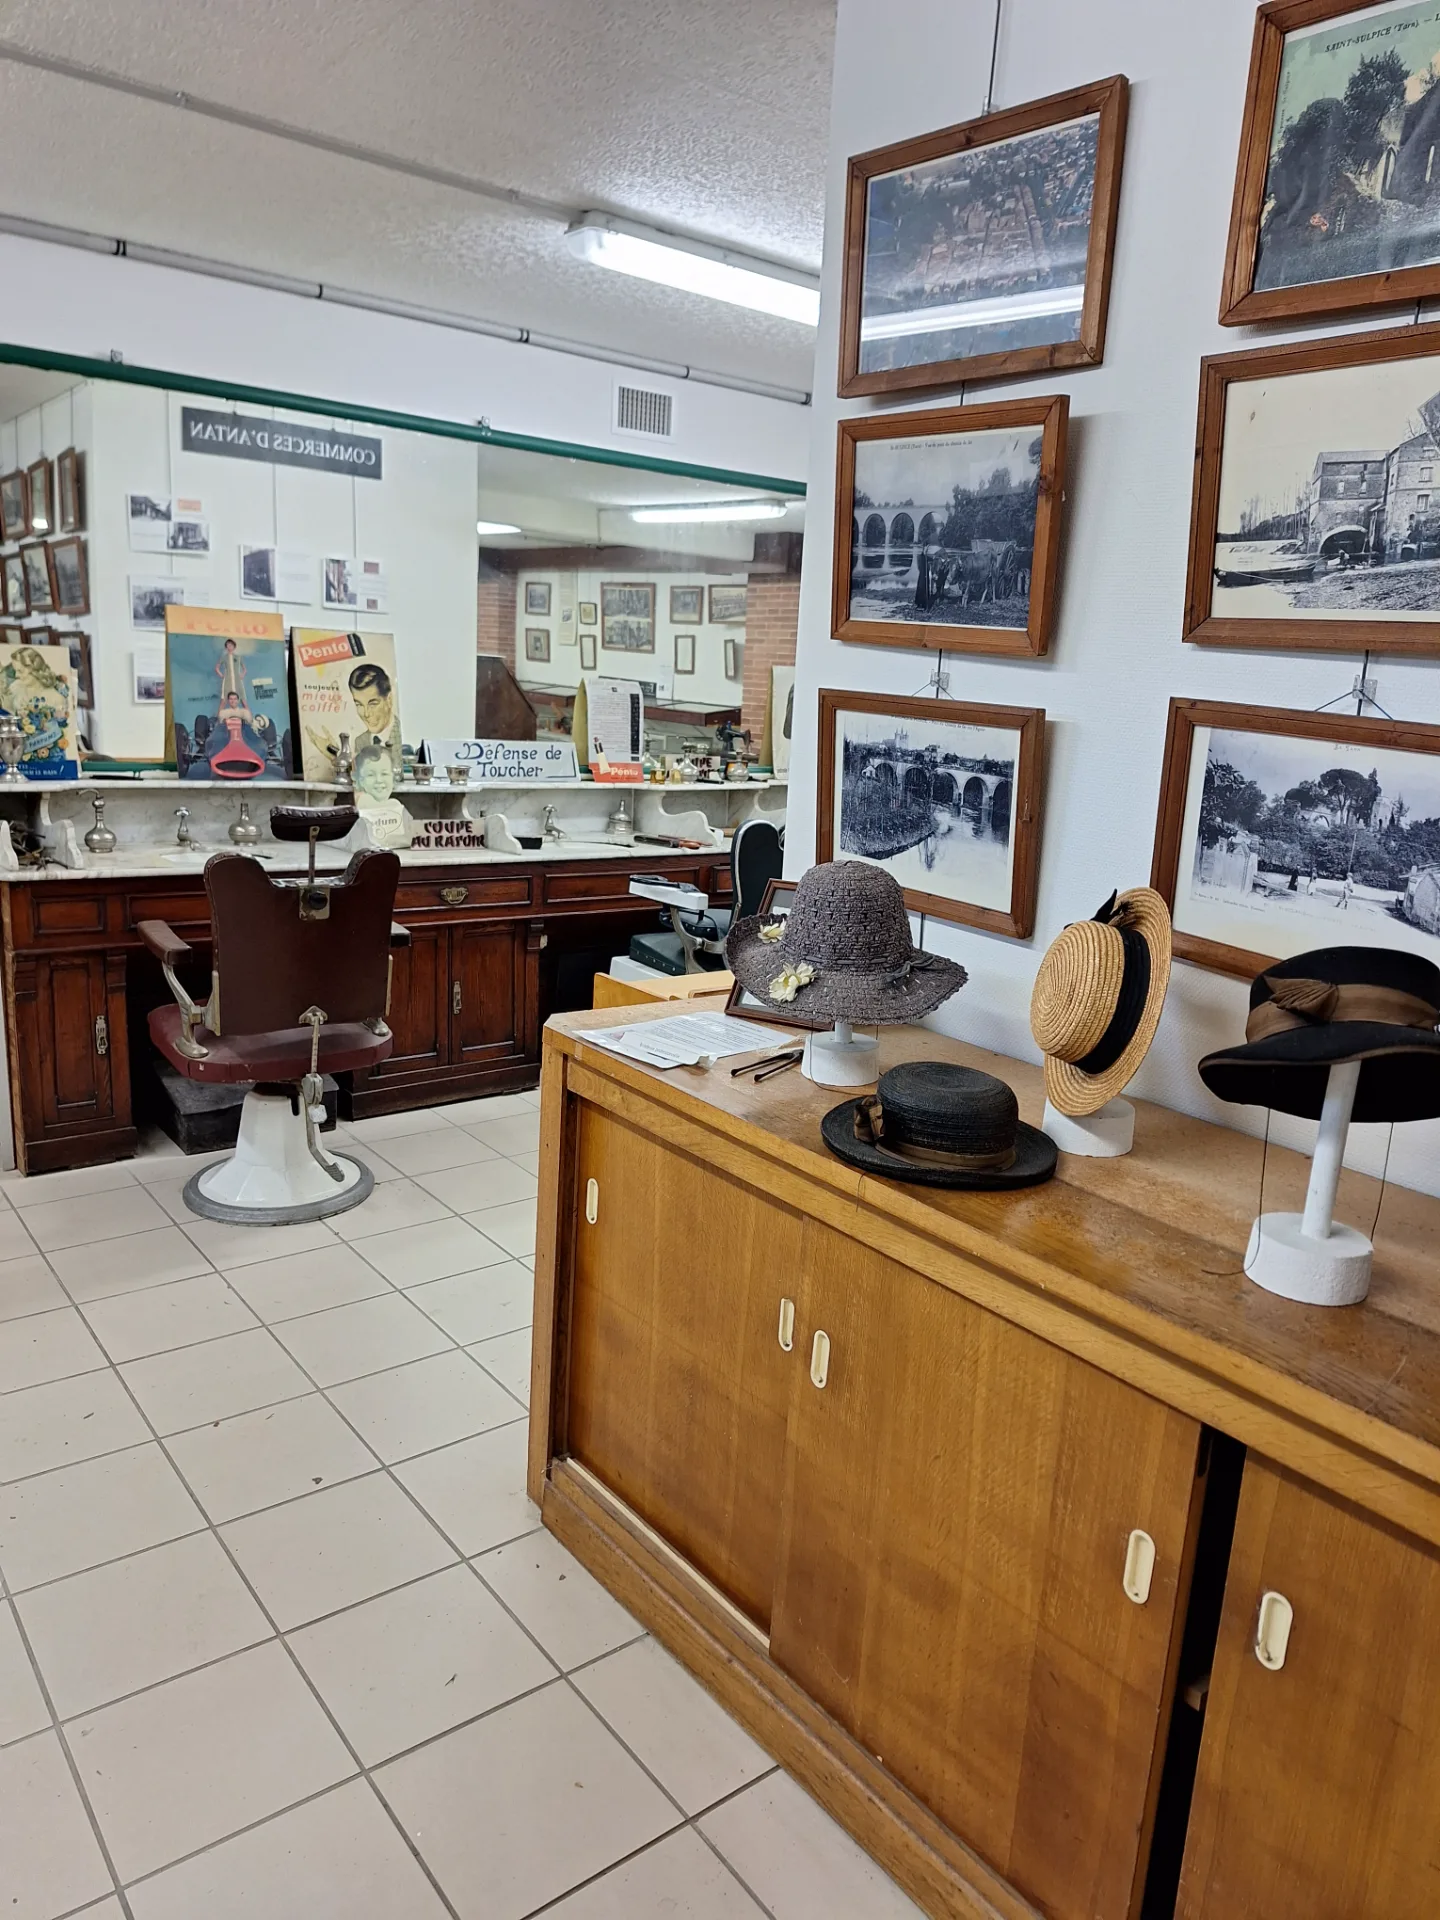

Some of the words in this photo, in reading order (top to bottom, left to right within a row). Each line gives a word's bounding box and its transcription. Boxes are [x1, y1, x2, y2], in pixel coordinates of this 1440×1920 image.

[1325, 26, 1392, 52] SAINT-SULPICE
[300, 641, 349, 661] Pento
[304, 684, 340, 692] toujours
[302, 692, 342, 701] mieux
[455, 742, 538, 760] Défense
[545, 745, 562, 760] de
[477, 761, 543, 778] Toucher
[424, 820, 473, 834] COUPE
[411, 835, 431, 848] AU
[434, 834, 484, 848] RASOIR
